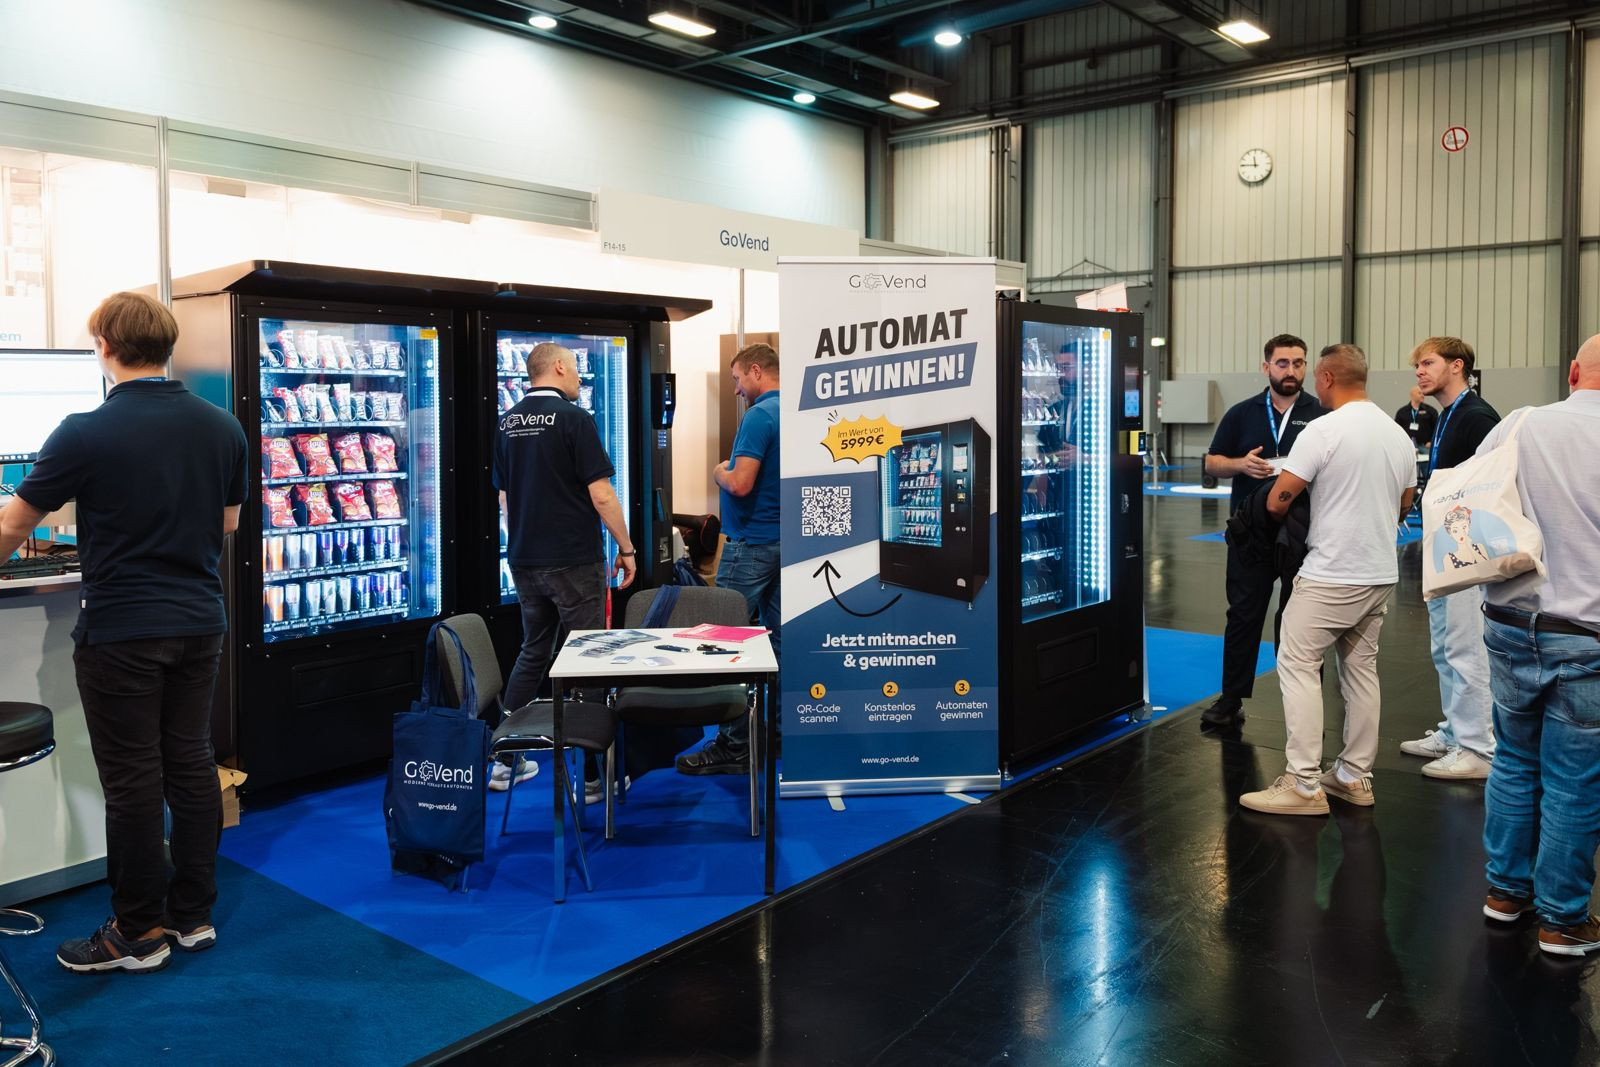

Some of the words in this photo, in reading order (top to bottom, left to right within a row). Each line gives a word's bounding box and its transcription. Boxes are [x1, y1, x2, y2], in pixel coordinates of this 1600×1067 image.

[719, 229, 769, 251] GoVend
[603, 241, 626, 251] F14-15
[815, 308, 968, 359] AUTOMAT
[815, 353, 965, 400] GEWINNEN!
[838, 430, 848, 438] Im
[850, 428, 867, 437] Wert
[868, 426, 884, 435] von
[822, 634, 865, 648] Jetzt
[867, 632, 956, 646] mitmachen
[843, 654, 856, 668] &
[859, 653, 936, 670] gewinnen
[797, 704, 841, 714] QR-Code
[864, 702, 916, 711] Konstenlos
[935, 701, 988, 710] Automaten
[799, 715, 838, 723] scannen
[868, 713, 912, 722] eintragen
[940, 711, 983, 721] gewinnen
[861, 755, 920, 765] www.go-vend.de
